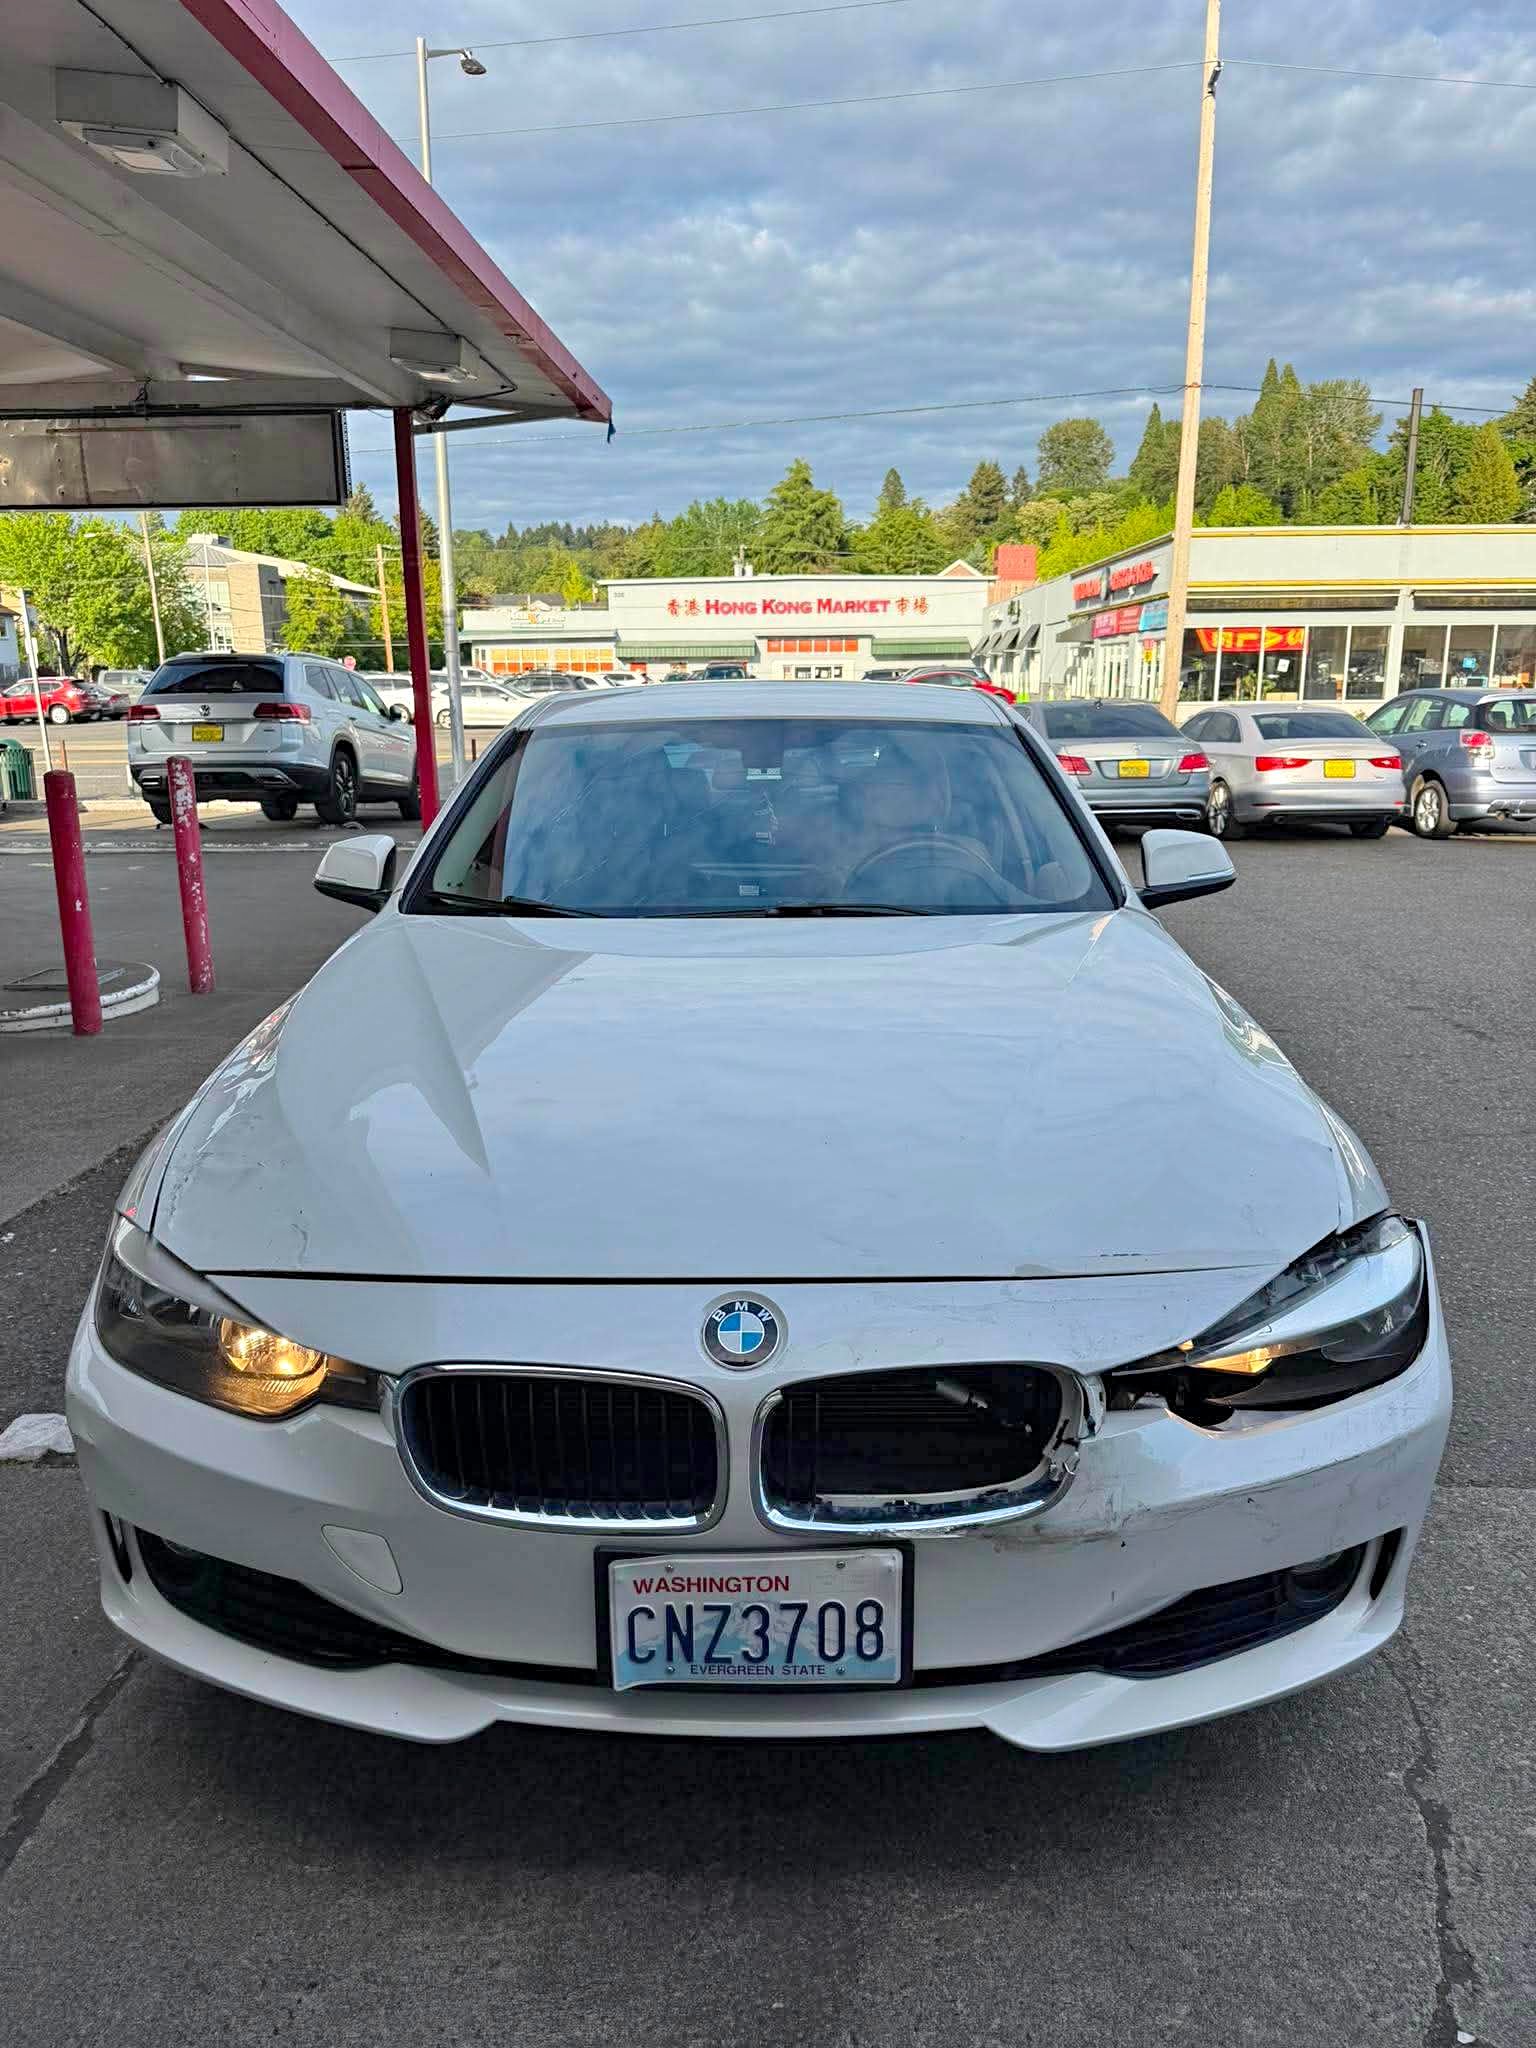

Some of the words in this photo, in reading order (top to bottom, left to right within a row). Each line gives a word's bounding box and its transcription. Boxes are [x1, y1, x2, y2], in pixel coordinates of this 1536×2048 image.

[705, 599, 757, 614] HONG
[762, 599, 812, 614] KONG
[817, 598, 890, 614] MARKET
[712, 1301, 773, 1322] BMW
[633, 1575, 790, 1594] WASHINGTON
[627, 1599, 884, 1665] CNZ3708
[690, 1663, 774, 1676] EVERGREEN
[781, 1664, 826, 1676] STATE
